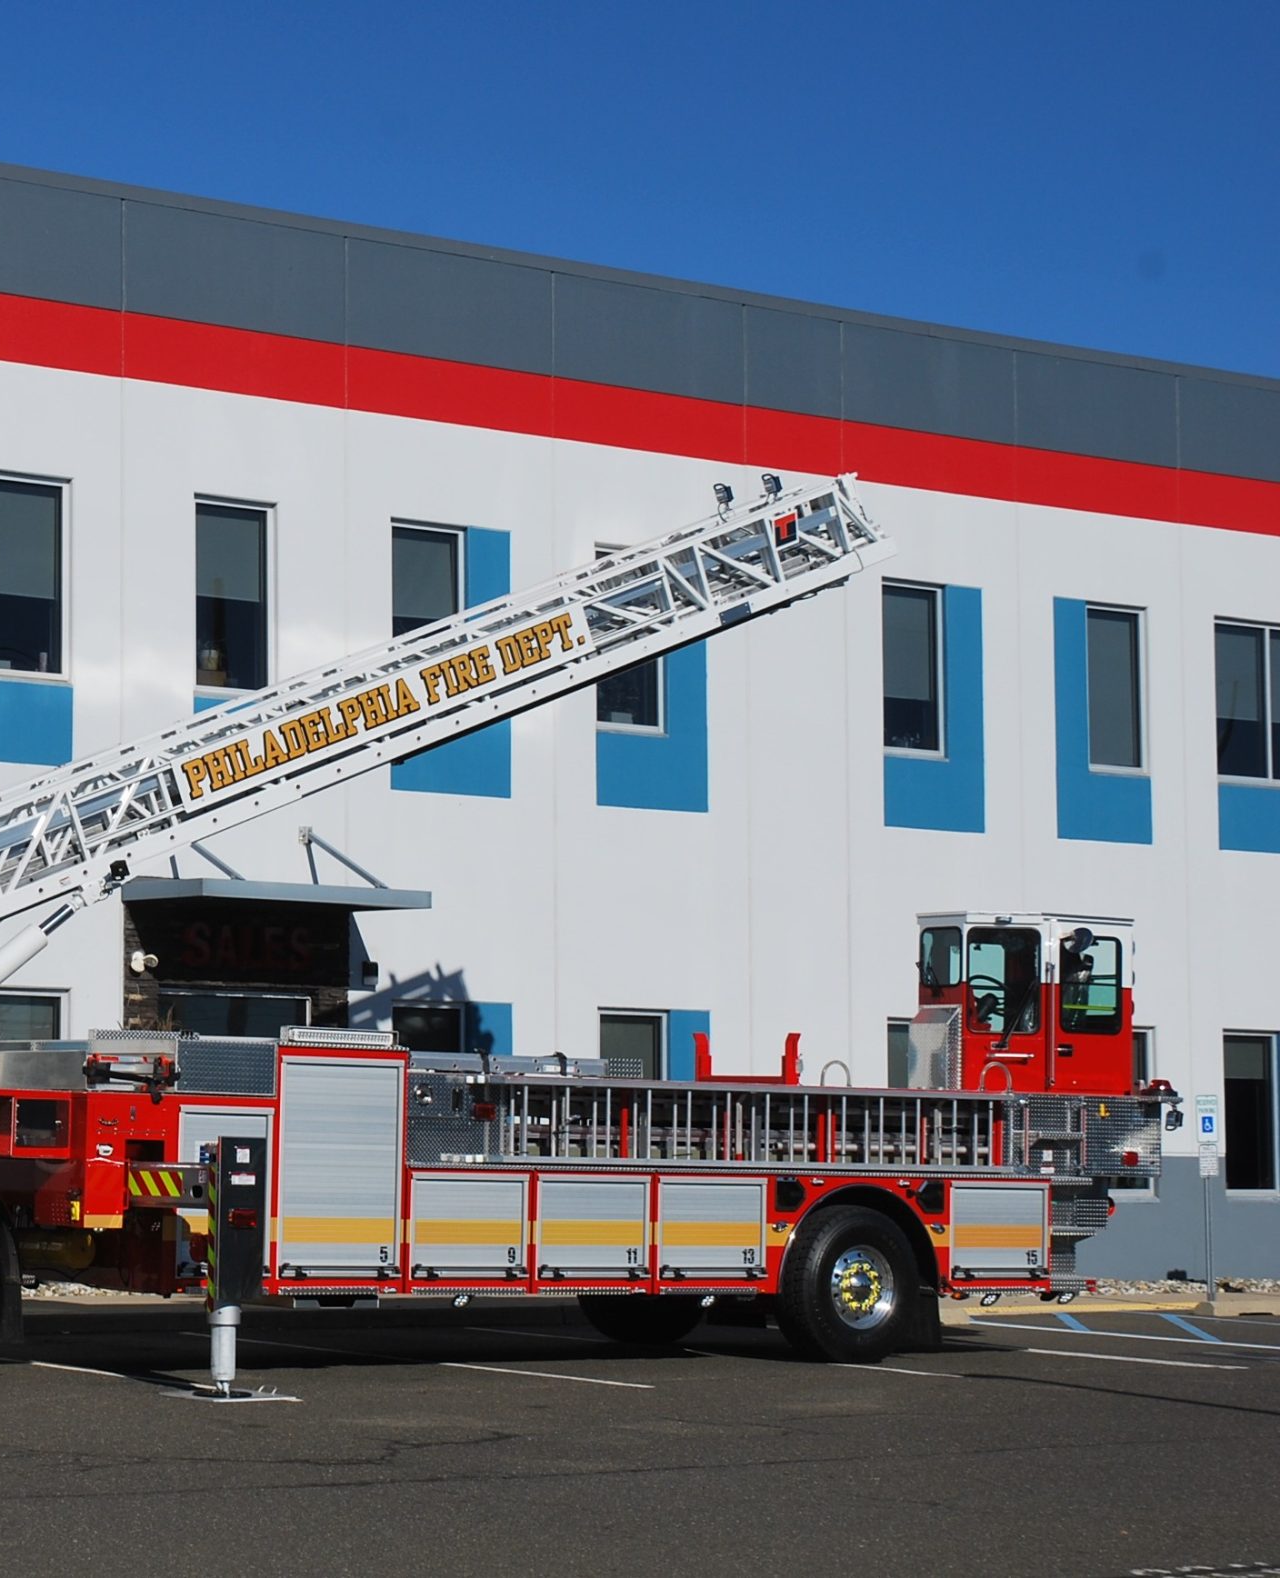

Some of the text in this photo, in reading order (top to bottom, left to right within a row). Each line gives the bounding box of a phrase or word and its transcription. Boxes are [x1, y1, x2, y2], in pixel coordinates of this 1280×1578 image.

[181, 612, 587, 800] PHILADELPHIA FIRE DEPT.
[180, 921, 313, 972] SALES
[379, 1246, 388, 1263] 5
[507, 1247, 516, 1264] 9
[626, 1247, 638, 1264] 11
[742, 1248, 755, 1265] 13
[1025, 1250, 1038, 1265] 15
